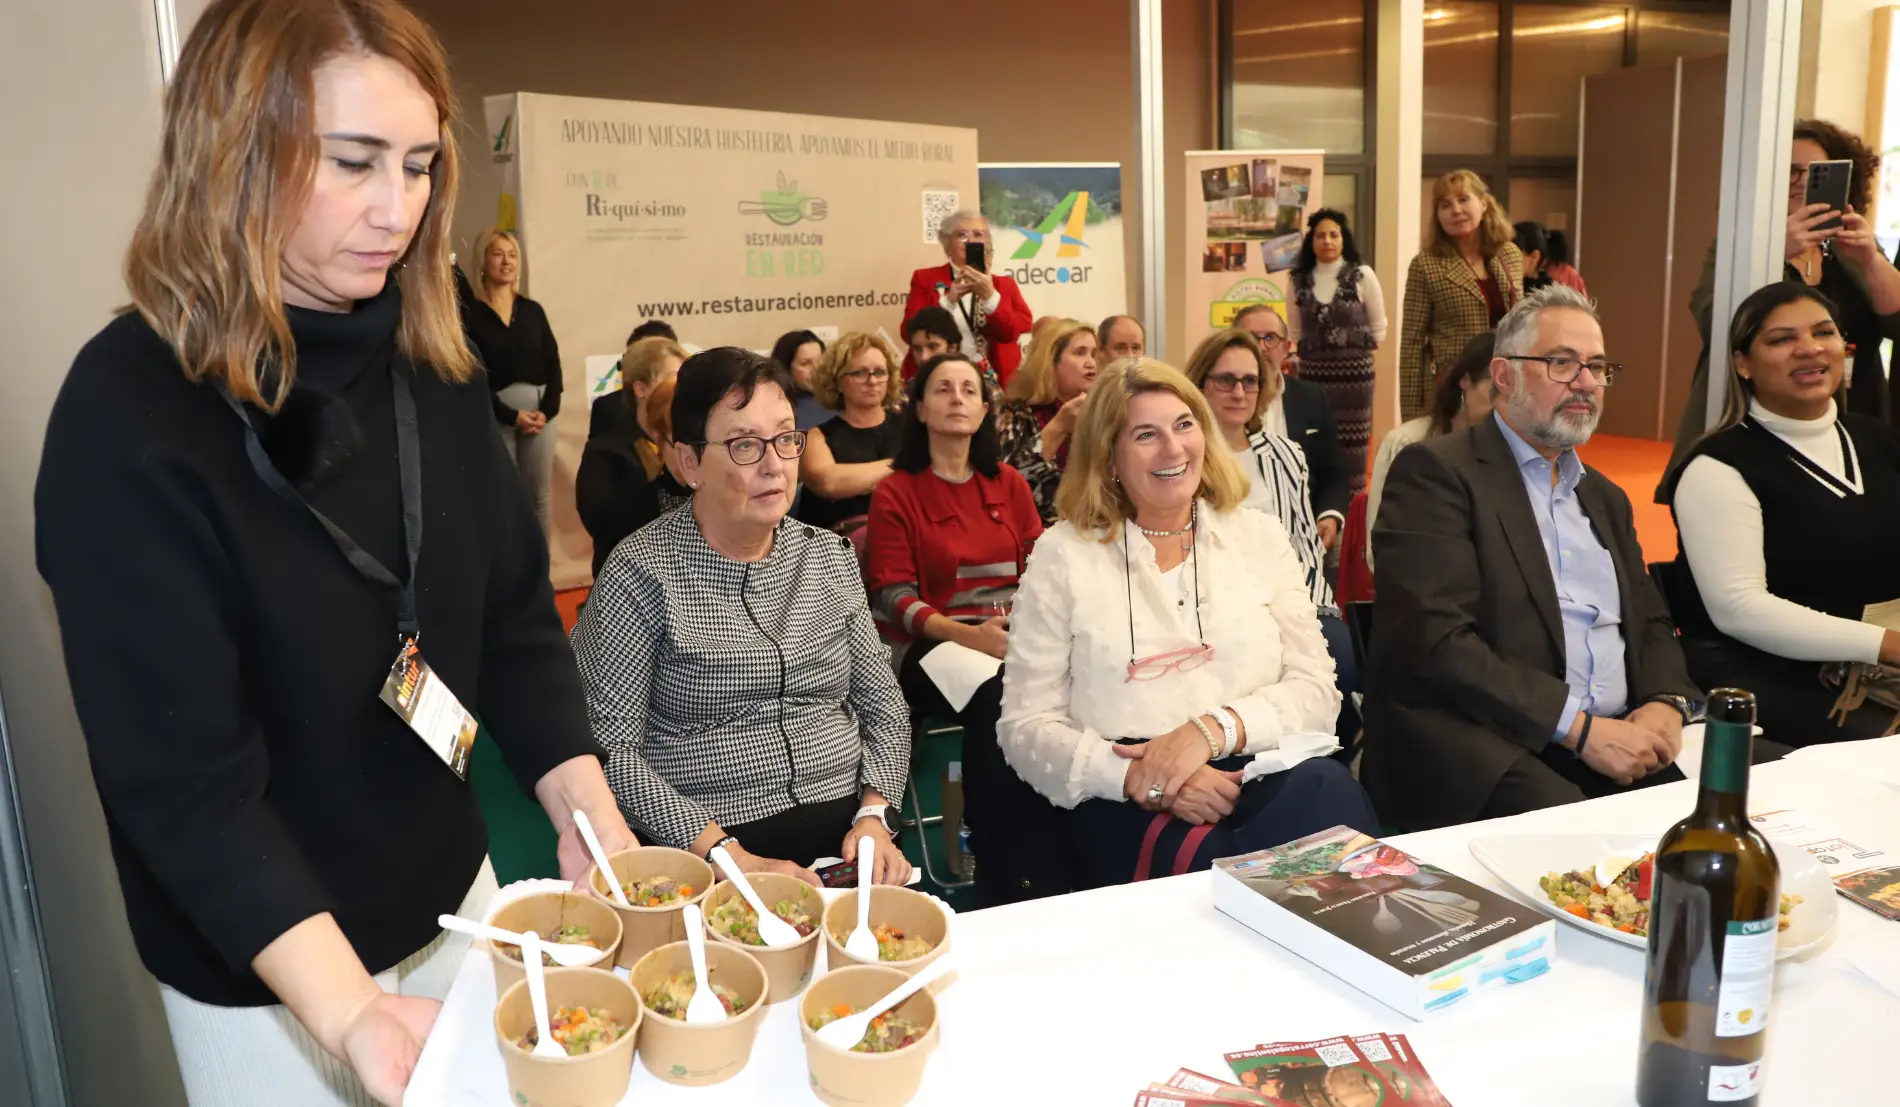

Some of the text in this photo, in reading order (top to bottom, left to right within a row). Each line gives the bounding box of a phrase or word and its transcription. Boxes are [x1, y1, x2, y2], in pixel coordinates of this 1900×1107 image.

[561, 119, 643, 146] APOYANDO
[648, 124, 712, 149] NUESTRA
[799, 134, 865, 158] APOYAMOS
[868, 138, 879, 159] EL
[884, 139, 919, 161] MEDIO
[922, 141, 954, 164] RURAL
[746, 248, 825, 277] EN RED
